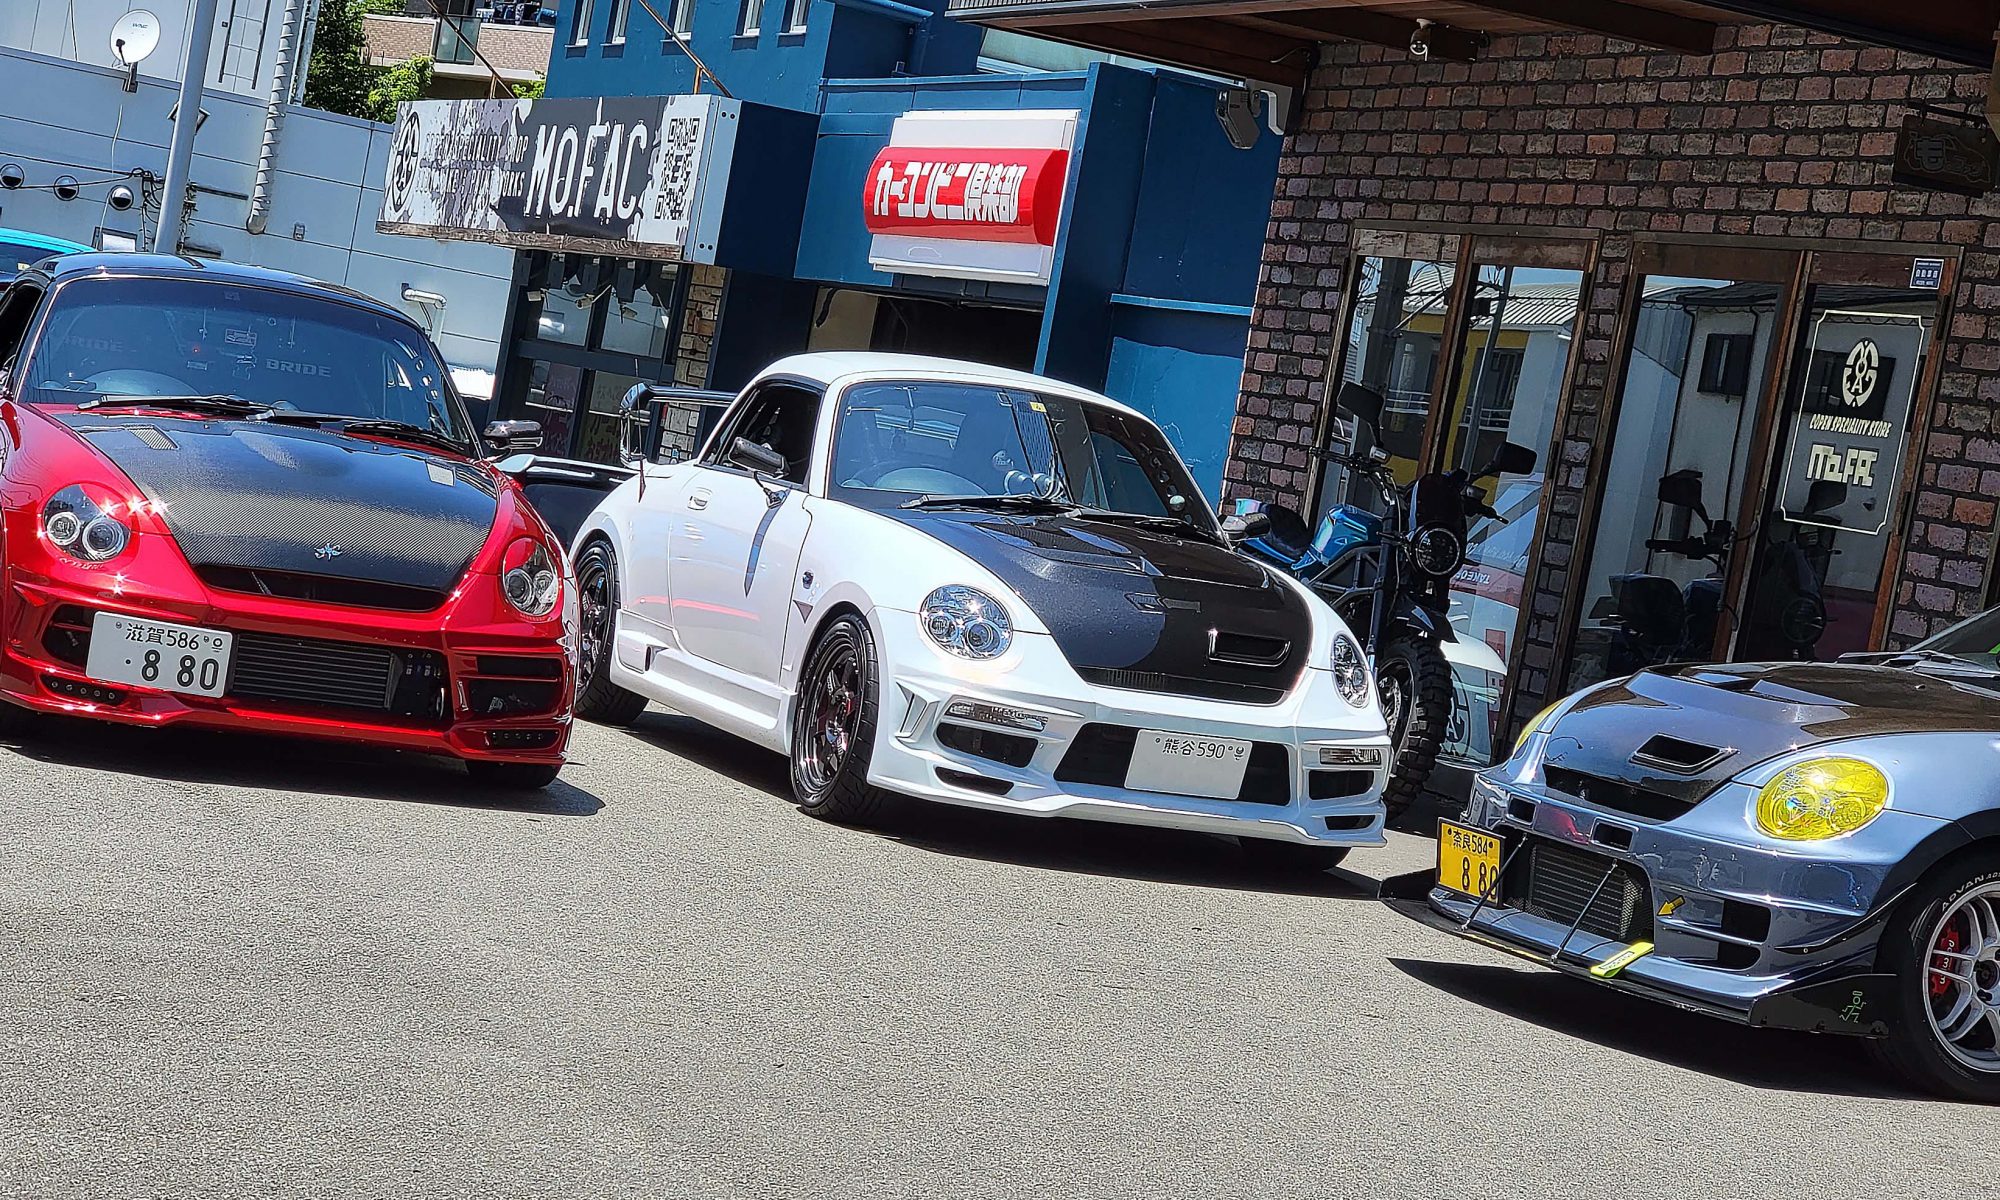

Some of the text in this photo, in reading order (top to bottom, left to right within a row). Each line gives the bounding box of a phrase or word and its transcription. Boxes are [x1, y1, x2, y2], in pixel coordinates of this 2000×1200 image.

[504, 135, 529, 164] SHOP
[873, 160, 1028, 224] カーコンビニ倶楽部
[265, 358, 332, 378] BRIDE
[1809, 413, 1892, 438] COPEN SPECIALITY STORE
[125, 622, 200, 651] 滋賀586
[1162, 738, 1226, 759] 熊谷590
[1453, 829, 1488, 857] 奈良584
[1942, 874, 1985, 912] ADVAN
